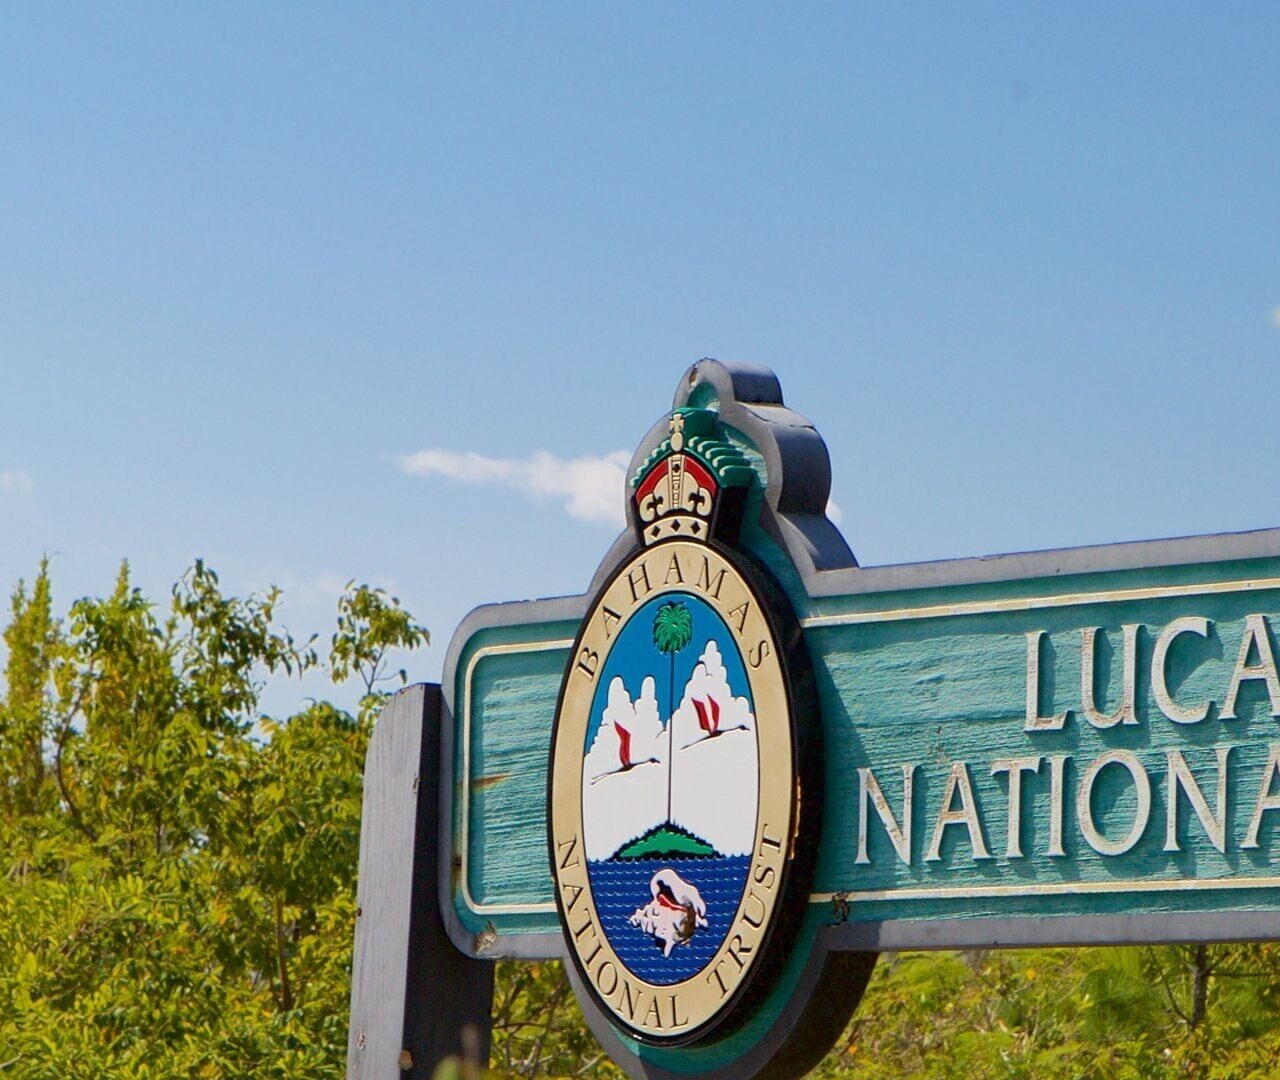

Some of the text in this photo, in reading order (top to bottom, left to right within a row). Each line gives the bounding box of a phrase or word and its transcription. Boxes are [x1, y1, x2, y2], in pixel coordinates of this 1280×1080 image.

[575, 551, 770, 682] BAHAMAS
[558, 823, 783, 1031] NATIONAL TRUST
